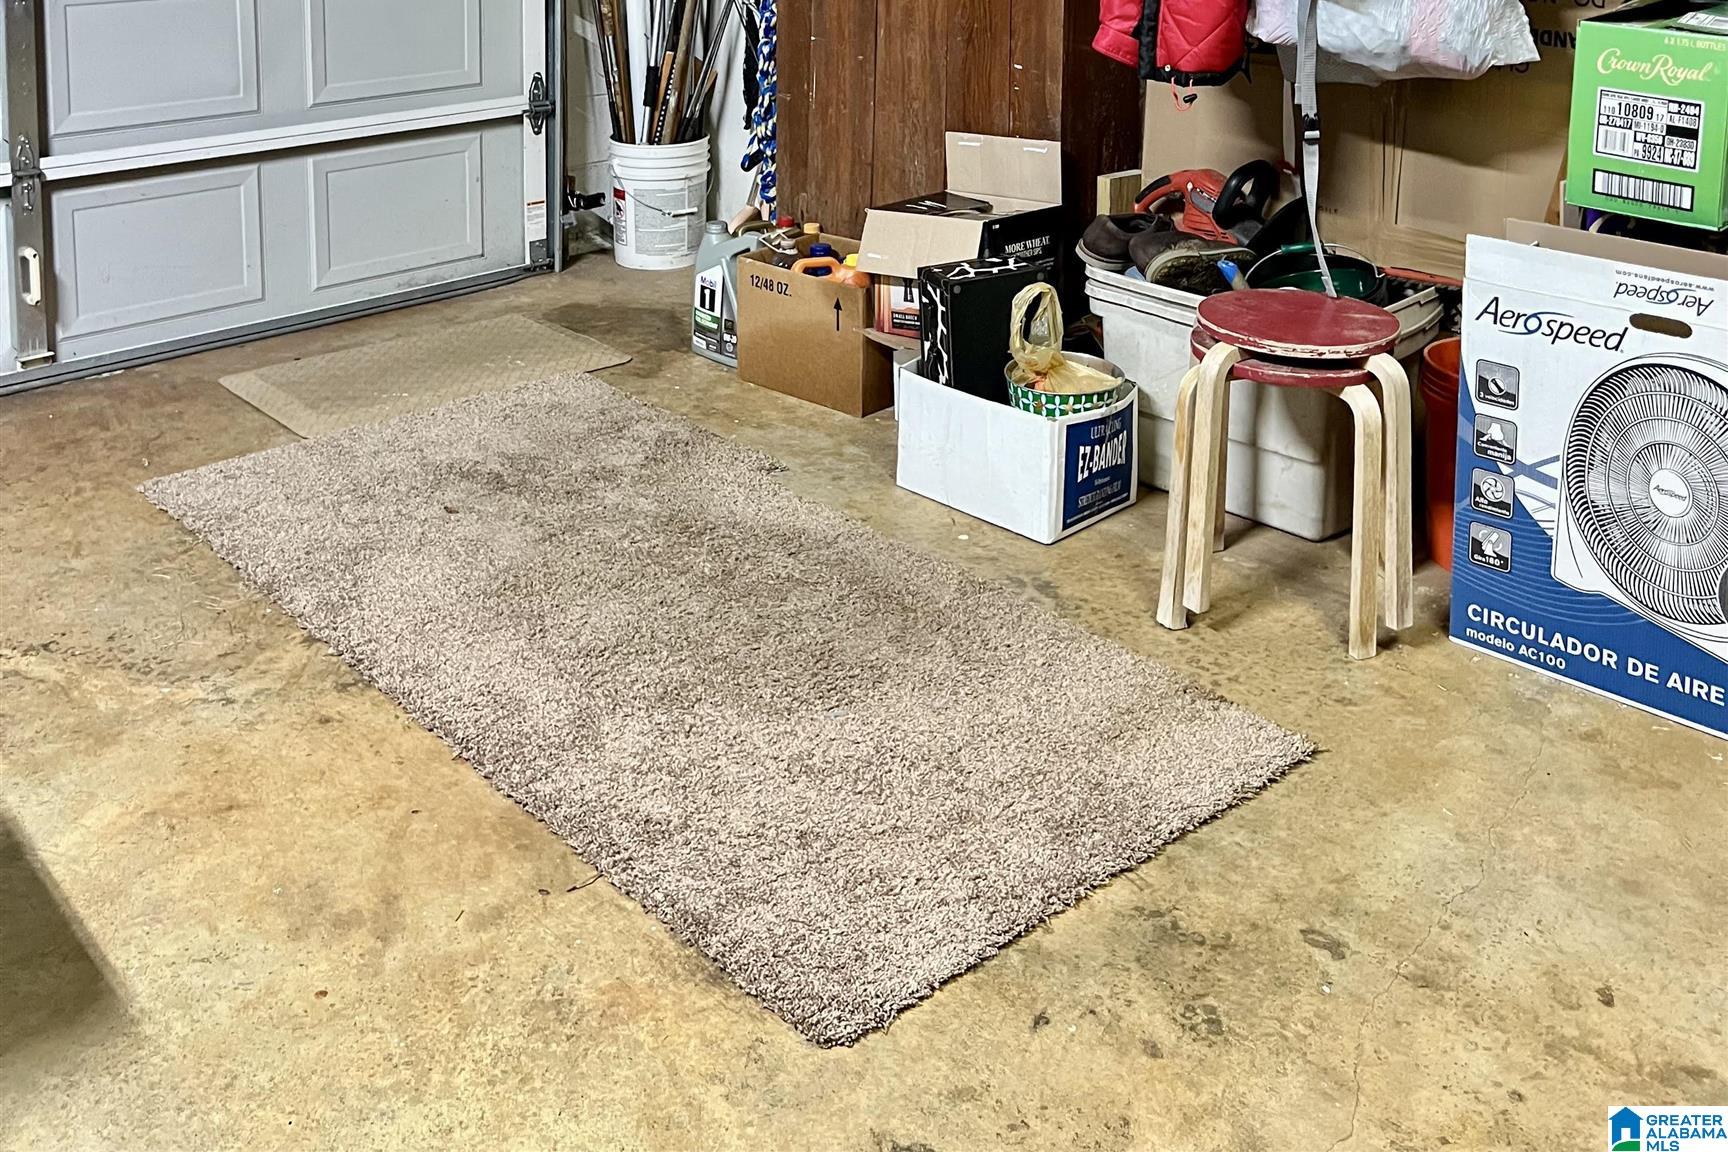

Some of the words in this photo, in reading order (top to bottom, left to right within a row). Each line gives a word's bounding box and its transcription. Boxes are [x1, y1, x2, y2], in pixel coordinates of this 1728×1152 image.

[1676, 37, 1690, 47] 1.75
[1696, 39, 1727, 51] BOTTLES
[1597, 48, 1651, 75] Crown
[1640, 54, 1713, 87] Royal
[1618, 101, 1654, 121] 10809
[1641, 144, 1662, 162] 9924
[1004, 241, 1026, 254] MORE
[1026, 235, 1050, 249] WHEAT
[700, 276, 717, 289] Mobil
[750, 274, 774, 292] 12/48
[776, 281, 793, 297] OZ.
[1613, 282, 1715, 317] Aerospeed
[1475, 296, 1629, 352] Aerospeed
[1077, 430, 1127, 483] EZ-BANDER
[1466, 626, 1515, 653] modelo
[1518, 644, 1566, 670] AC100
[1467, 604, 1618, 670] CIRCULADOR
[1627, 656, 1660, 684] DE
[1666, 672, 1726, 707] AIRE
